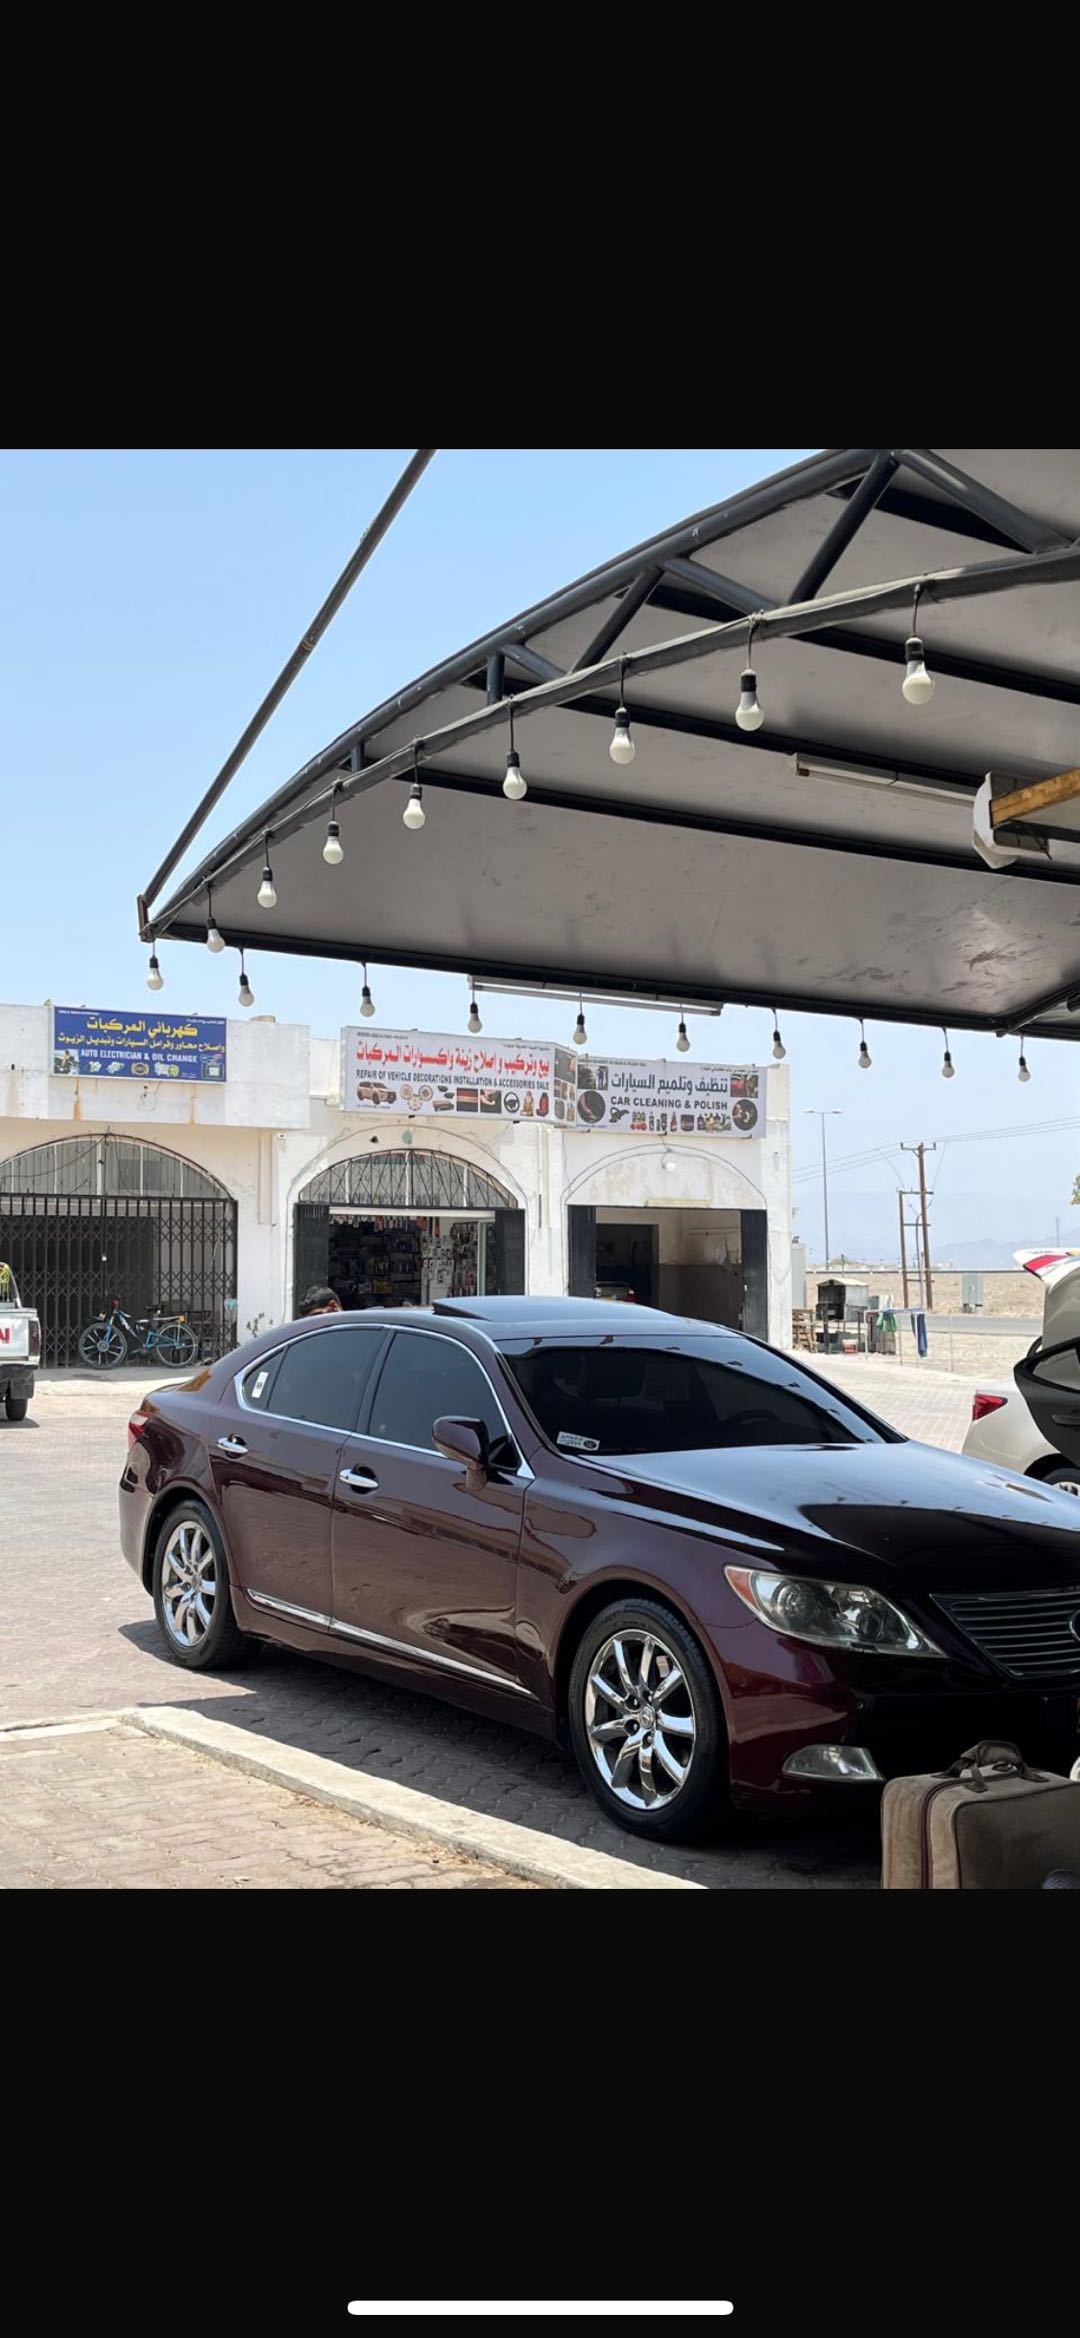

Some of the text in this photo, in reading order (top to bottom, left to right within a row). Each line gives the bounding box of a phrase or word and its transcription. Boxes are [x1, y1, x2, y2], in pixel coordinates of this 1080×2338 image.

[86, 1015, 146, 1035] المركبات
[115, 1036, 149, 1048] السيارات
[80, 1049, 198, 1063] AUTO ELECTRICIAN & OIL CHANGE
[356, 1041, 401, 1066] المركبات
[356, 1069, 550, 1090] REPAIR OF VEHICLE DECORATIONS INSTALLATION & ACCESSORIES SALE
[611, 1072, 728, 1096] تنظيف وتلميع السيارات
[610, 1096, 728, 1110] CAR CLEANING & POLISH
